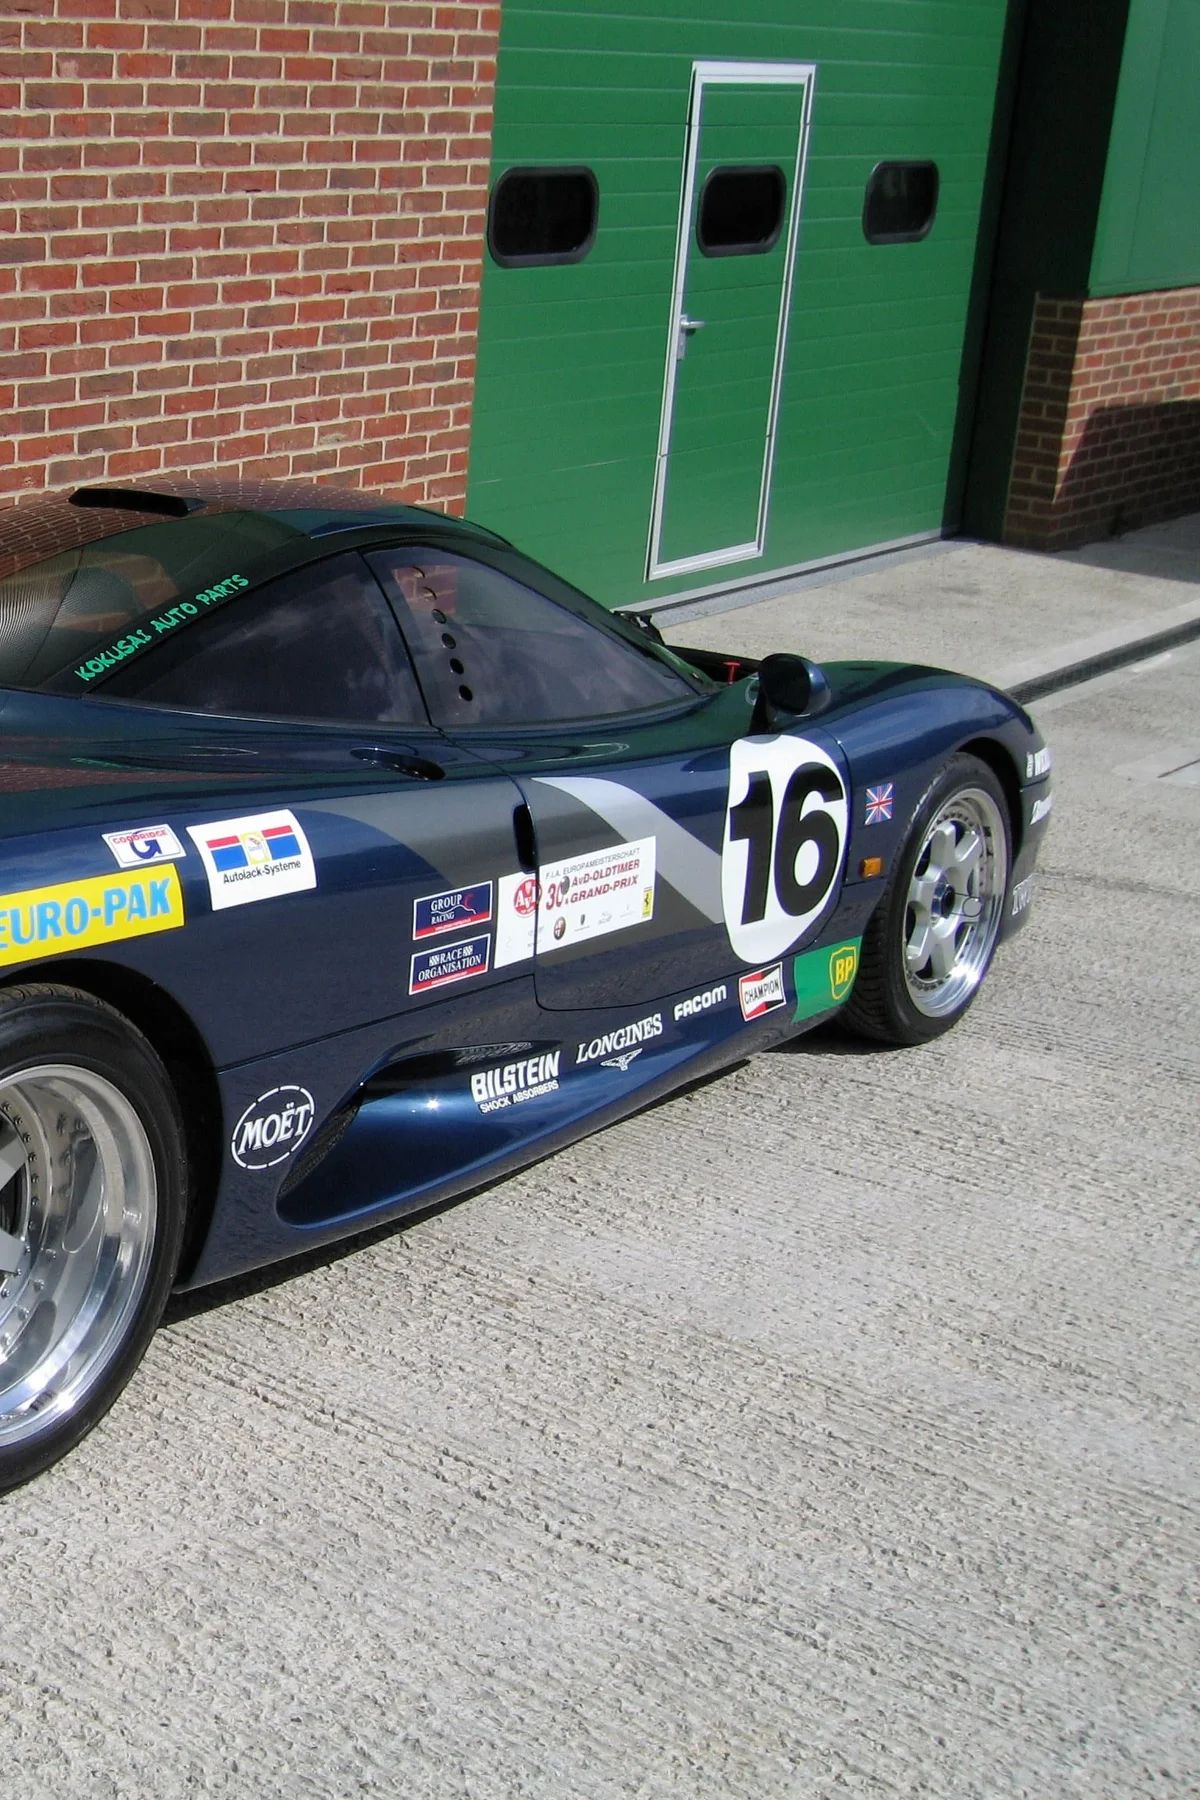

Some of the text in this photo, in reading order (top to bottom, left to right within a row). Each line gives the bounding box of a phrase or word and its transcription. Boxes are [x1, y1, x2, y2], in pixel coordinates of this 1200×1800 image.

[74, 574, 249, 681] KOKUSAI AUTO PARTS
[112, 829, 168, 845] GOODRIDGE
[729, 761, 844, 926] 16
[223, 860, 302, 885] Autolack-Systeme
[562, 847, 641, 876] EUROPAMEISTERSCHAFT
[571, 858, 641, 888] AvD-OLDTIMER
[430, 893, 462, 912] GROUP
[570, 875, 640, 904] GRAND-PRIX
[430, 910, 455, 925] RACING
[417, 953, 482, 981] ORGANISATION
[438, 947, 464, 964] RACE
[835, 955, 856, 986] BP
[744, 979, 780, 1006] CHAMPION
[575, 1013, 663, 1065] LONGINES
[471, 1051, 561, 1103] BILSTEIN
[480, 1080, 559, 1114] SHOCK ABSORBERS
[237, 1102, 311, 1155] MOËT
